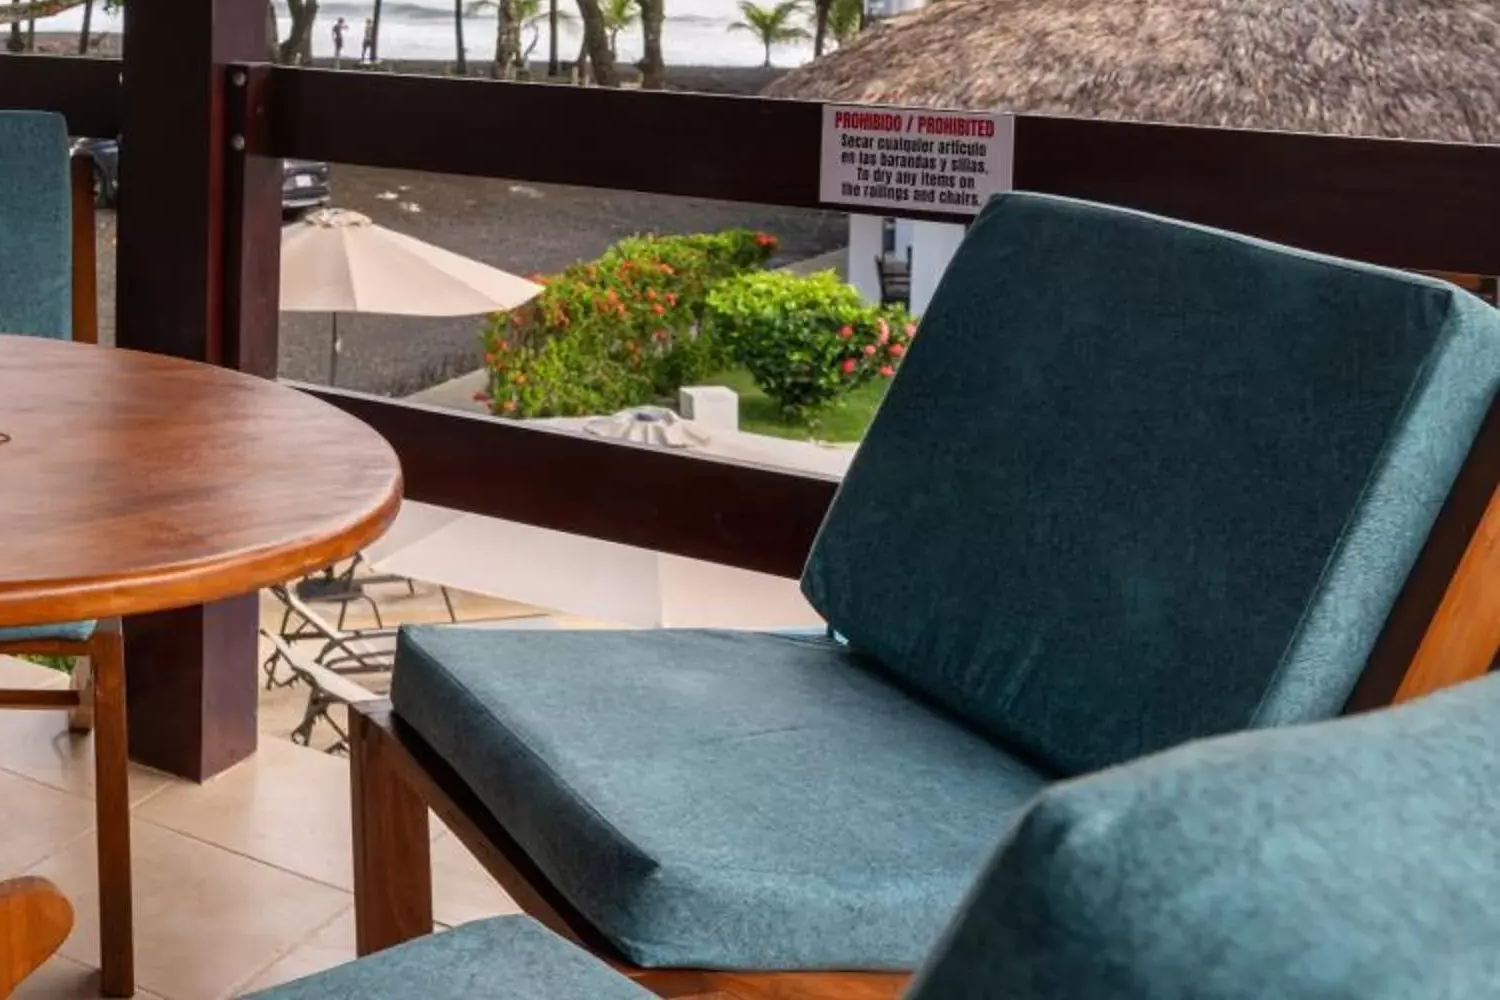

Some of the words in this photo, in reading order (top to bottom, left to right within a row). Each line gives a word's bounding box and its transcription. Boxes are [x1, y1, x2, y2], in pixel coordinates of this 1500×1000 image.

[835, 112, 901, 131] PROHIBIDO
[906, 115, 913, 132] /
[918, 116, 995, 137] PROHIBITED
[841, 134, 874, 150] Secar
[878, 136, 934, 155] cualquier
[842, 152, 854, 164] en
[860, 152, 876, 166] las
[880, 153, 936, 170] barandas
[940, 159, 947, 172] y
[857, 168, 869, 181] To
[874, 169, 892, 185] dry
[896, 172, 916, 186] any
[921, 172, 956, 187] items
[960, 175, 975, 188] on
[842, 182, 860, 196] the
[864, 184, 908, 201] railings
[914, 188, 935, 203] and
